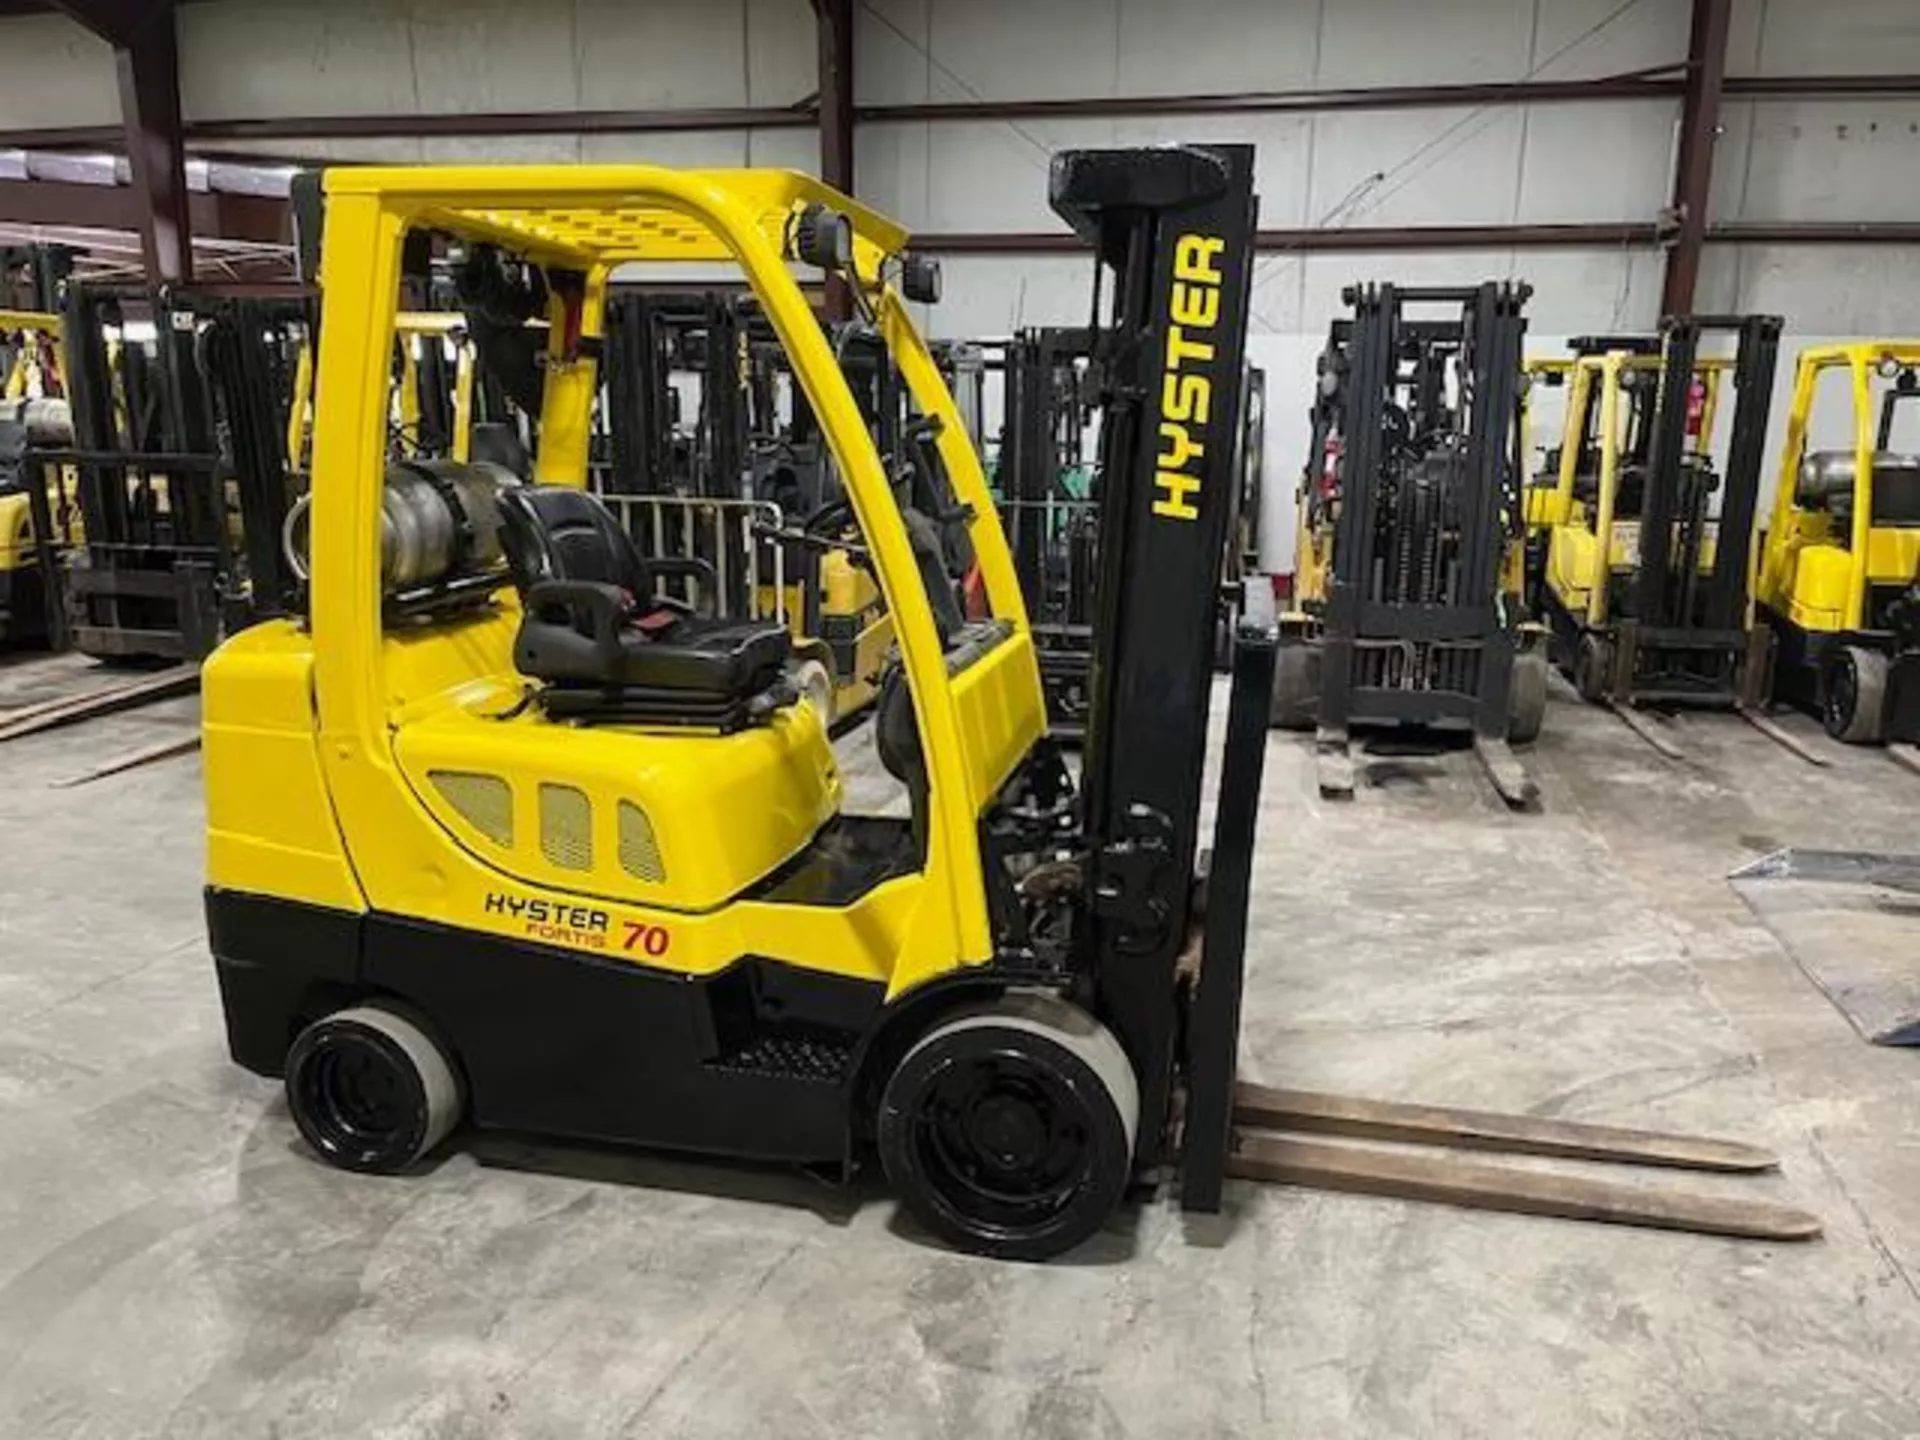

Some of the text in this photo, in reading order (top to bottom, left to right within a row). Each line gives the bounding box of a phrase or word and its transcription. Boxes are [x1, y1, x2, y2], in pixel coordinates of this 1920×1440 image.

[1151, 234, 1225, 521] HYSTER
[485, 893, 609, 932] HYSTER
[525, 922, 605, 948] FORTIS
[622, 920, 670, 957] 70
